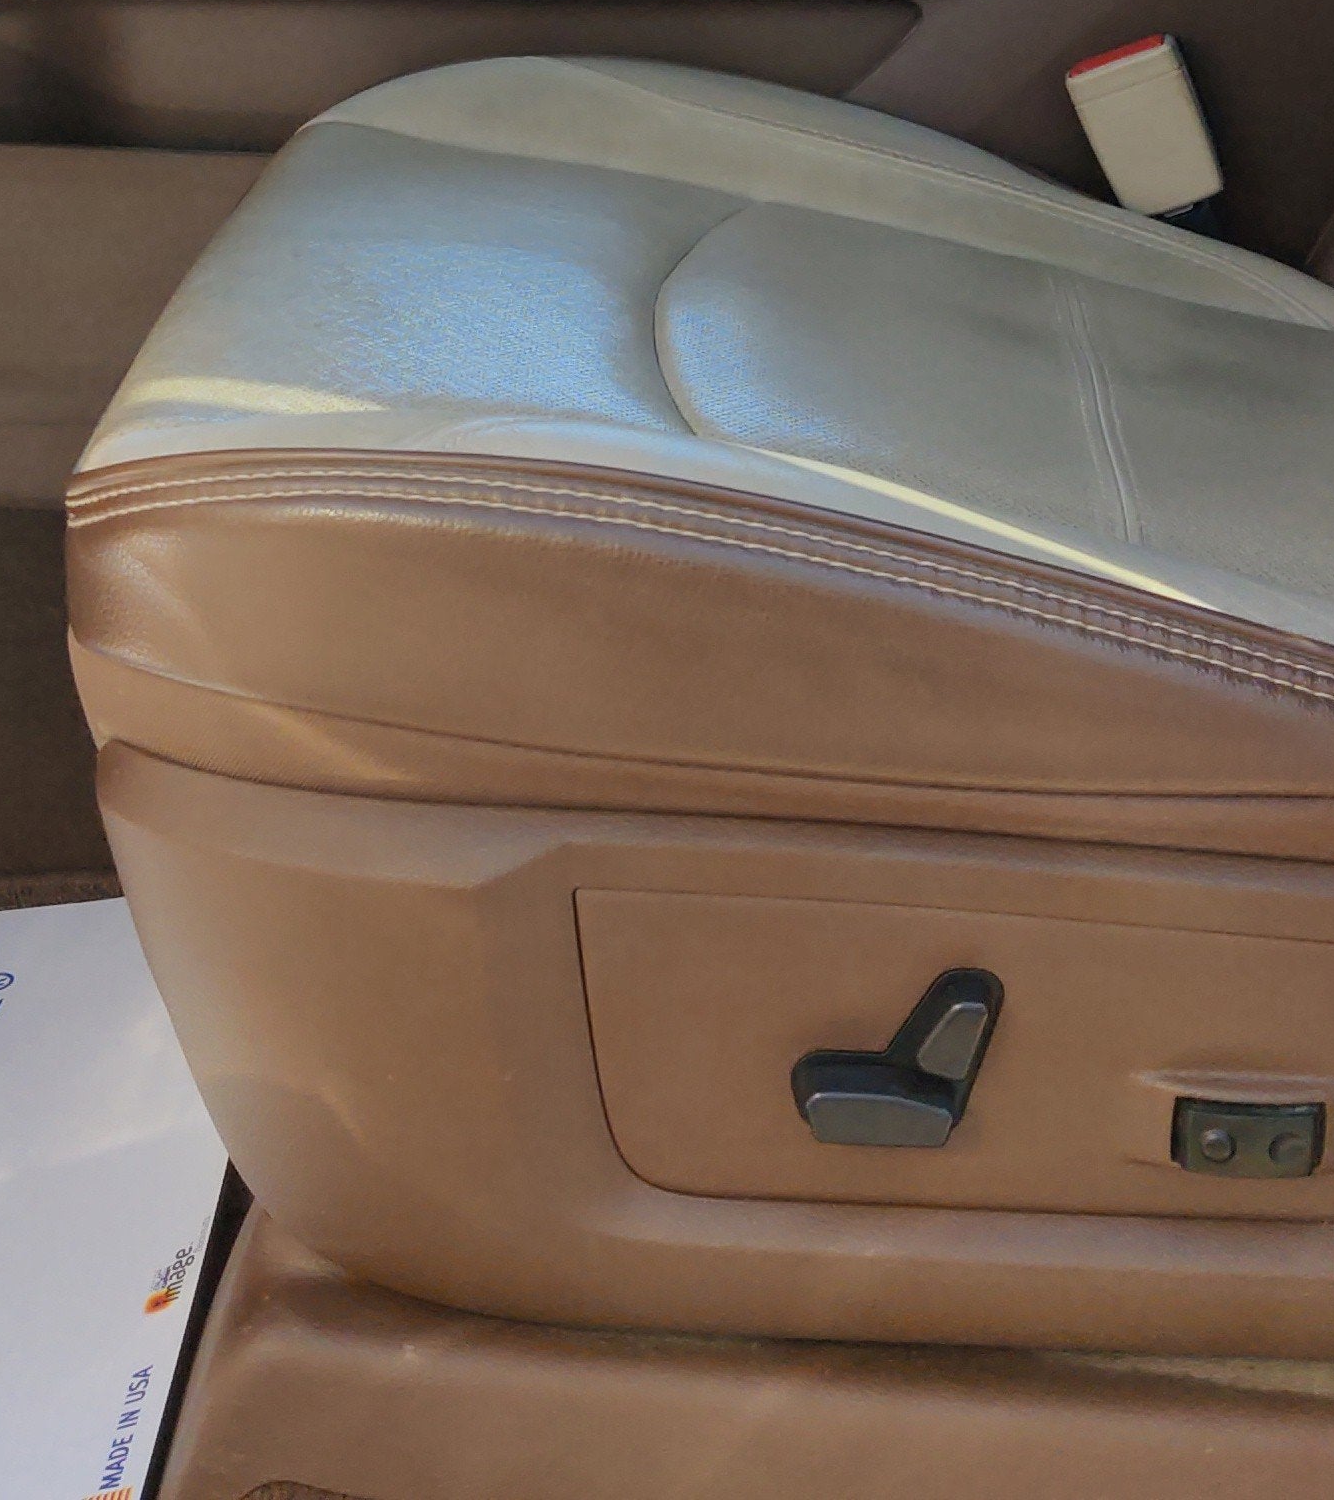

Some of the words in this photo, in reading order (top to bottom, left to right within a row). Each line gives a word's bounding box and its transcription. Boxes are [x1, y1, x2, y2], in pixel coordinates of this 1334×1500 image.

[124, 1364, 154, 1406] USA
[116, 1408, 142, 1431] IN
[98, 1434, 134, 1490] MADE
